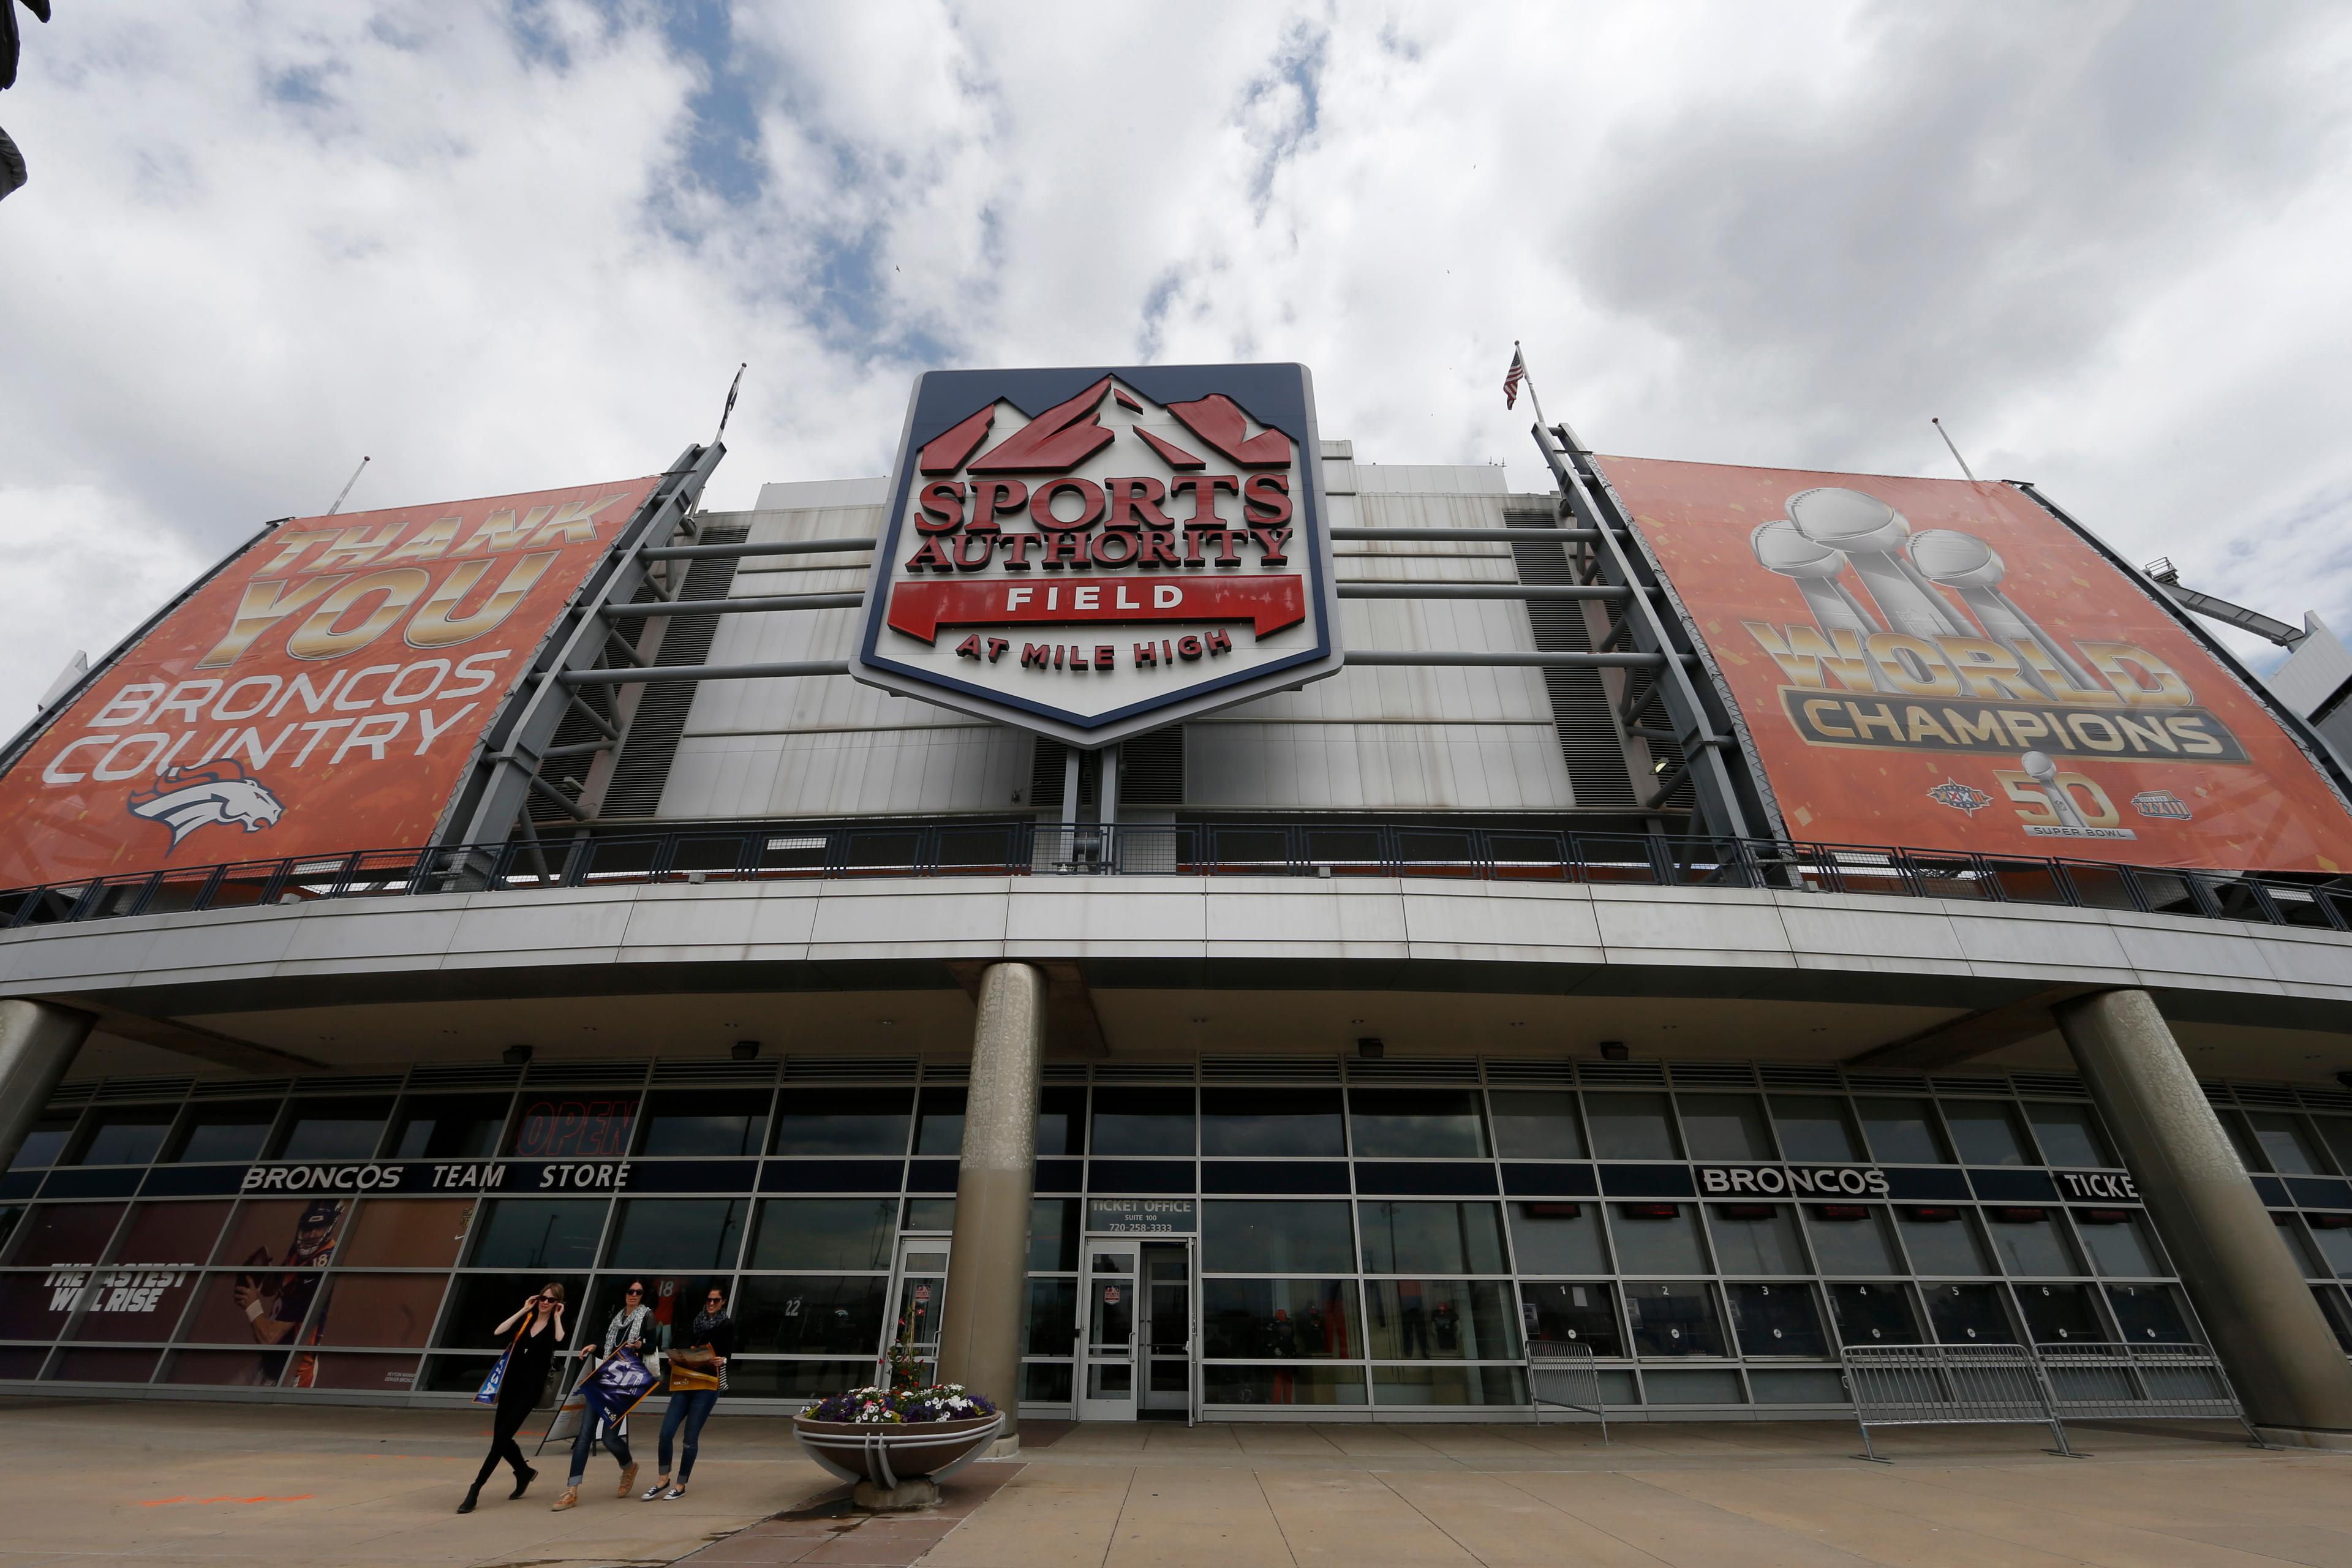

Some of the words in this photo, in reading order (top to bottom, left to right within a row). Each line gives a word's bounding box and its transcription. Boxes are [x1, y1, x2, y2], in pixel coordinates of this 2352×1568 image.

[914, 475, 1293, 536] SPORTS
[250, 492, 631, 578] THANK
[905, 528, 1293, 572] AUTHORITY
[194, 549, 564, 669] YOU
[1006, 585, 1183, 611] FIELD
[956, 634, 1009, 663] AT
[1020, 643, 1114, 671] MILE
[1133, 628, 1232, 668] HIGH
[1744, 621, 2194, 707] WORLD
[86, 649, 512, 728] BRONCOS
[1803, 699, 2224, 755] CHAMPIONS
[42, 701, 480, 783] COUNTRY
[1992, 770, 2120, 827] 50
[2034, 827, 2081, 836] SUPER
[518, 1100, 641, 1156] OPEN
[240, 1165, 404, 1189] BRONCOS
[432, 1165, 506, 1188] TEAM
[540, 1164, 631, 1188] STORE
[1703, 1167, 1890, 1193] BRONCOS
[1093, 1200, 1138, 1212] TICKET
[1144, 1200, 1191, 1212] OFFICE
[1109, 1223, 1172, 1232] 720-258-3333
[43, 1263, 92, 1286] THE
[100, 1263, 195, 1287] ASTEST
[48, 1287, 104, 1311] WIL
[103, 1288, 165, 1312] RISE
[658, 1280, 674, 1297] 18
[1559, 1286, 1566, 1295] 1
[1662, 1286, 1670, 1295] 2
[1762, 1286, 1769, 1295] 3
[1860, 1286, 1867, 1296] 4
[1951, 1286, 1959, 1295] 5
[2042, 1287, 2049, 1296] 6
[2128, 1287, 2135, 1296] 7
[785, 1300, 801, 1316] 22
[482, 1359, 505, 1395] VISA
